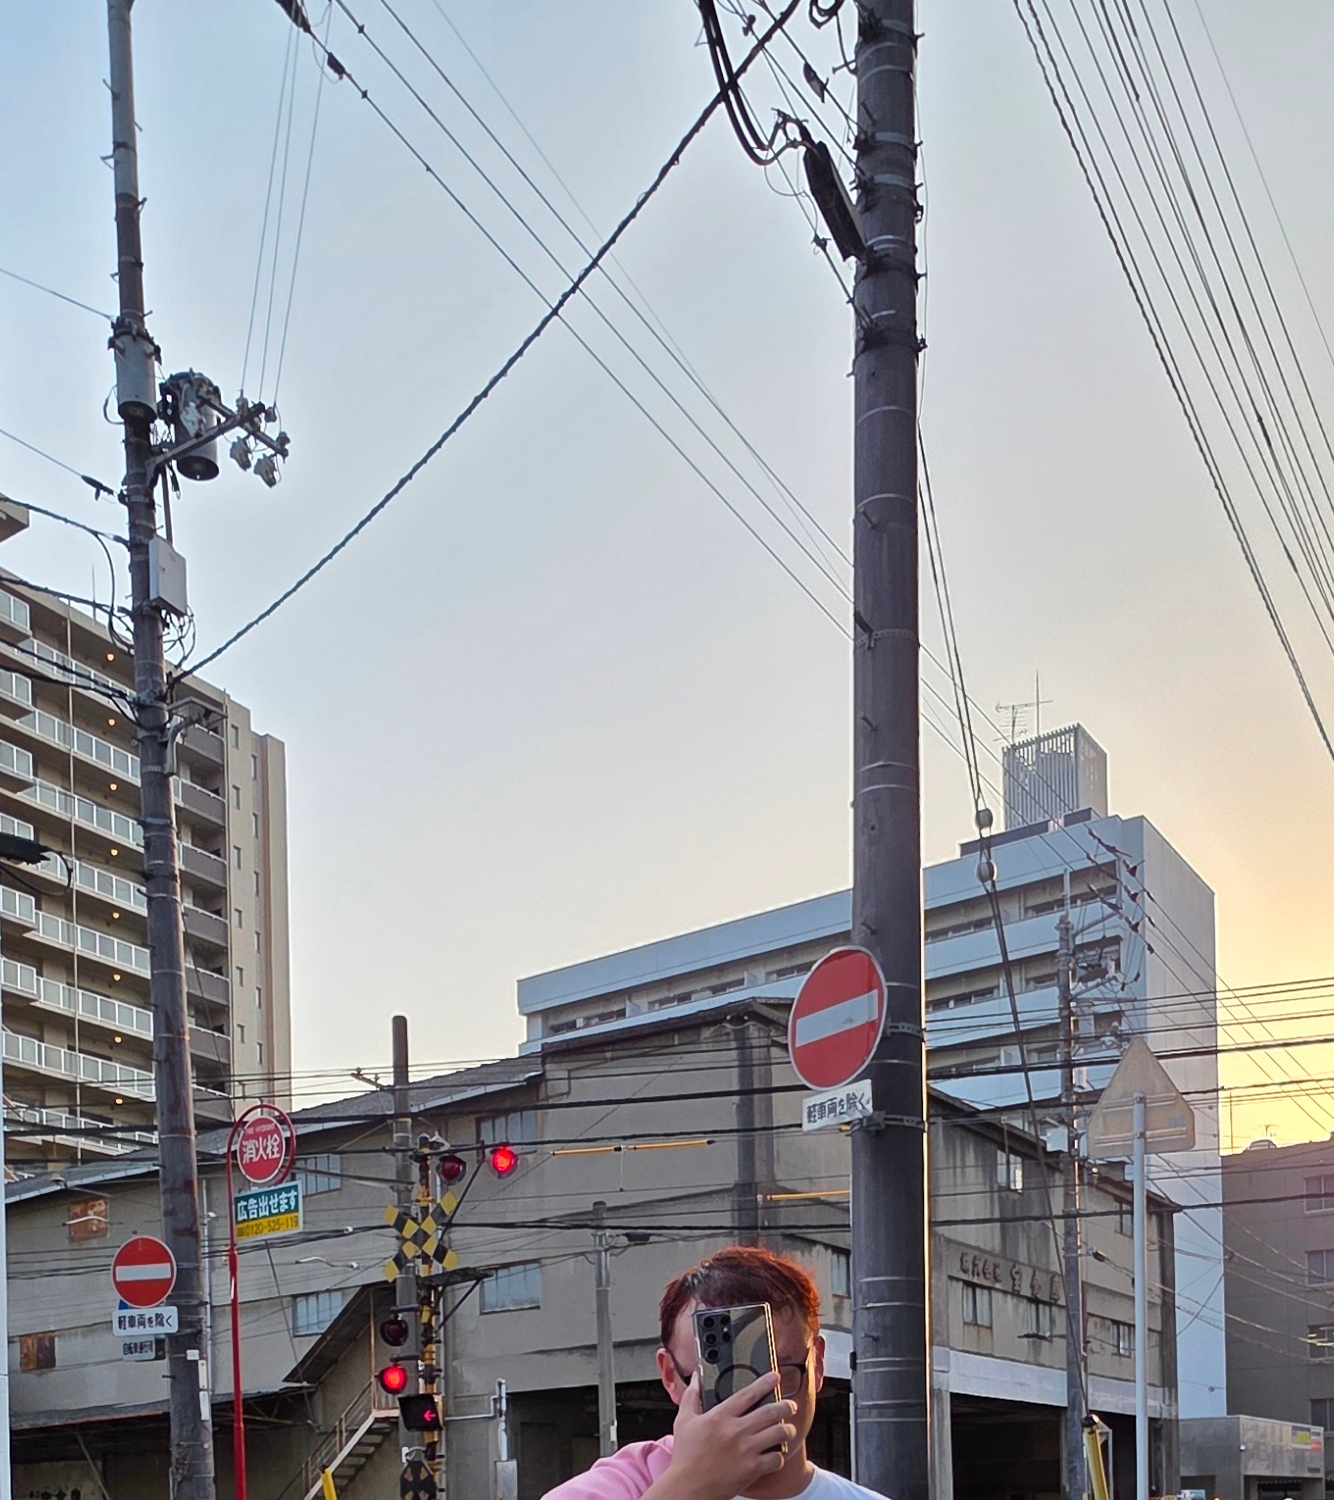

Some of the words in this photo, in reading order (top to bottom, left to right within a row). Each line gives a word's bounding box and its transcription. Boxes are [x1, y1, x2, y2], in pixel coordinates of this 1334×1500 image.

[806, 1092, 867, 1124] 軽車両を除く
[242, 1133, 280, 1165] 消火栓
[237, 1189, 298, 1221] 広告出せます
[118, 1312, 172, 1330] 軽車両を除く
